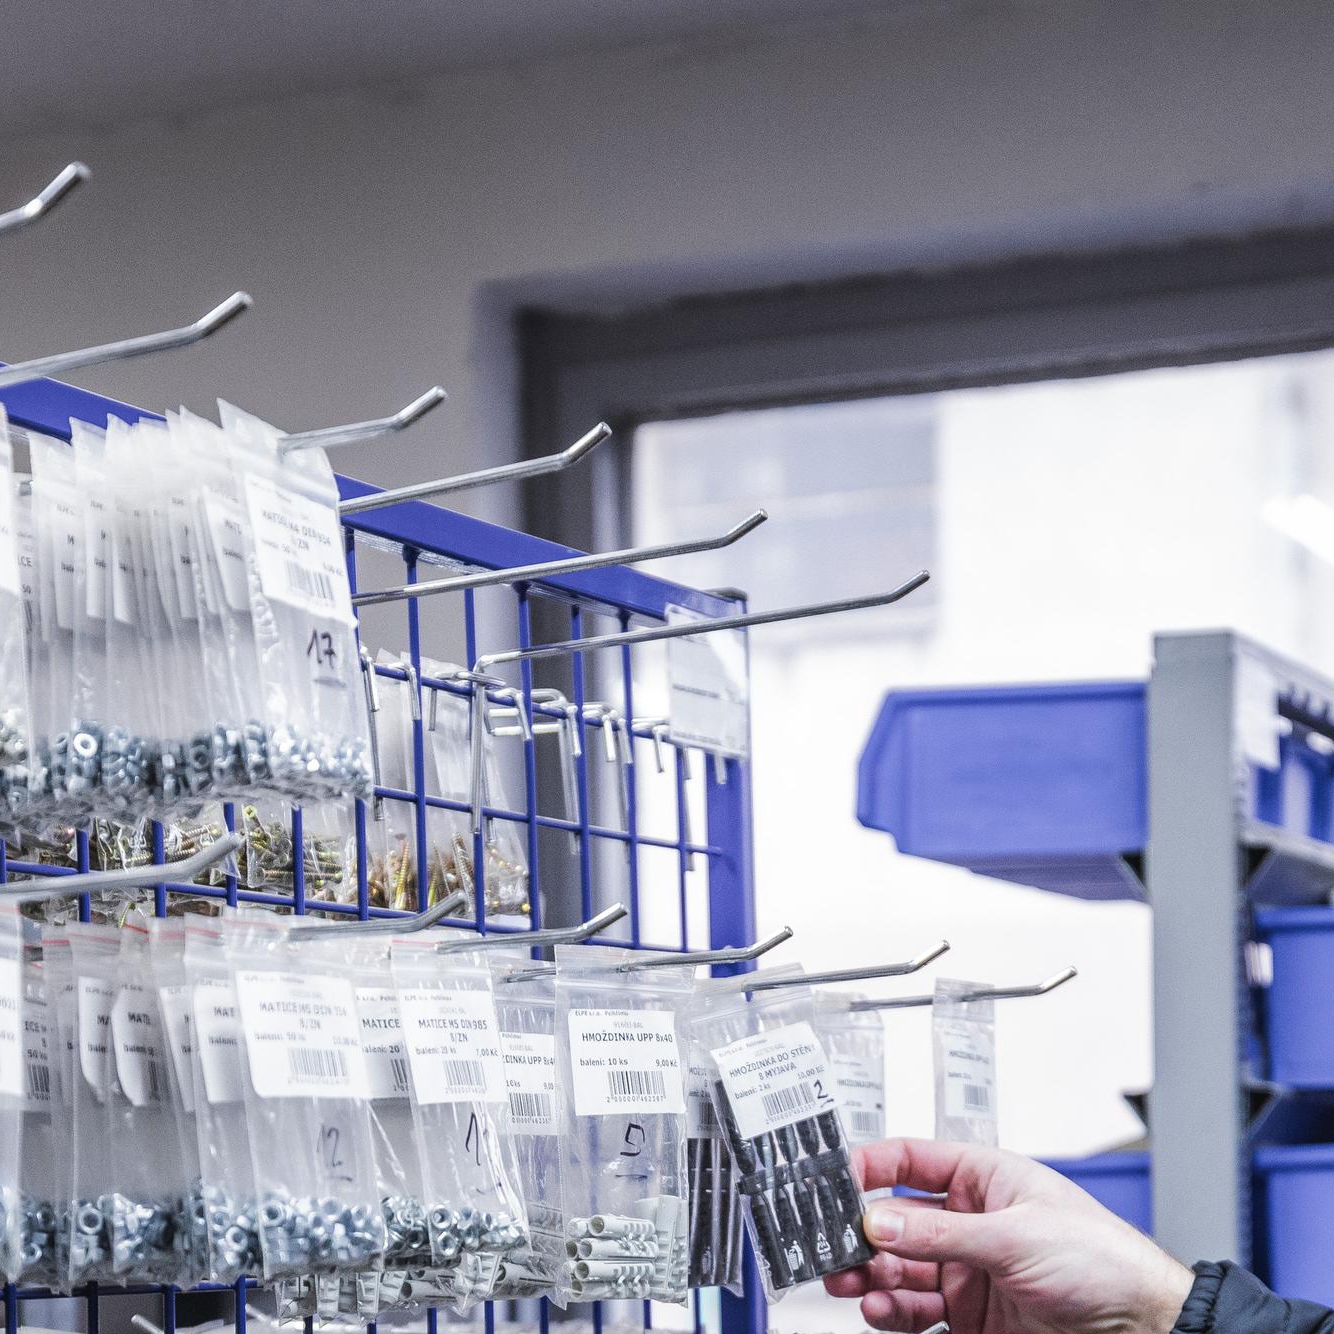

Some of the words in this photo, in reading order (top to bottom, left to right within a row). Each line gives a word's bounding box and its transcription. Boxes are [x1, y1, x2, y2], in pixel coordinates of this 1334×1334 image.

[362, 1018, 401, 1029] MATICE
[418, 1018, 448, 1030] MATICE
[581, 1030, 635, 1042] HMOŽDINKA
[636, 1033, 654, 1042] UPP
[655, 1033, 673, 1043] 8x40
[527, 1055, 542, 1066] UPP
[607, 1057, 617, 1066] 10
[728, 1056, 777, 1078] HMOŽDINKA
[777, 1052, 790, 1063] DO
[765, 1061, 797, 1078] MYJAVA
[813, 1079, 828, 1100] 2
